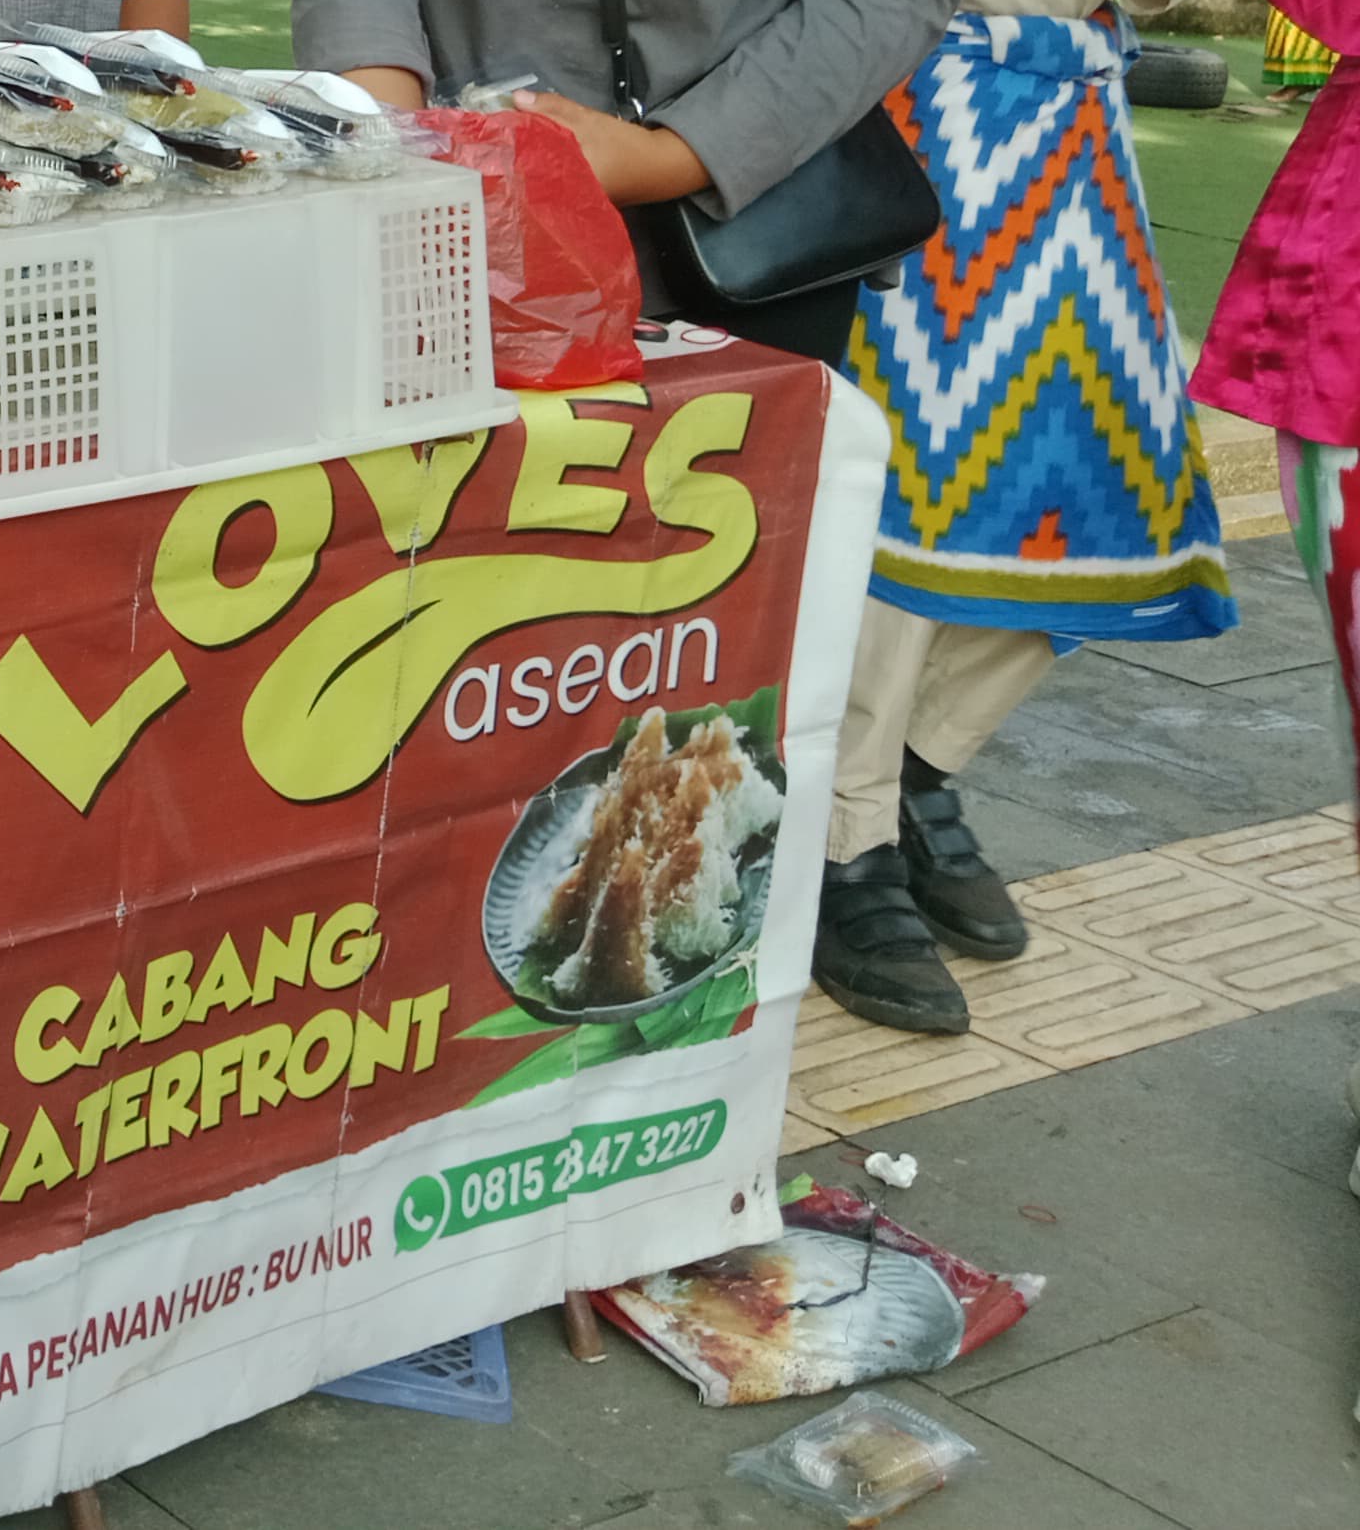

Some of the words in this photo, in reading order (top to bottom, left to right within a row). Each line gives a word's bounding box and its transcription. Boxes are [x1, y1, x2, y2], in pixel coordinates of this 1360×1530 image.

[443, 618, 719, 743] asean
[13, 901, 382, 1085] CABANG
[461, 1154, 544, 1219] 0815
[636, 1110, 716, 1168] 3227
[27, 1290, 176, 1390] PESANAN
[263, 1241, 307, 1292] BU
[311, 1215, 373, 1277] NUR
